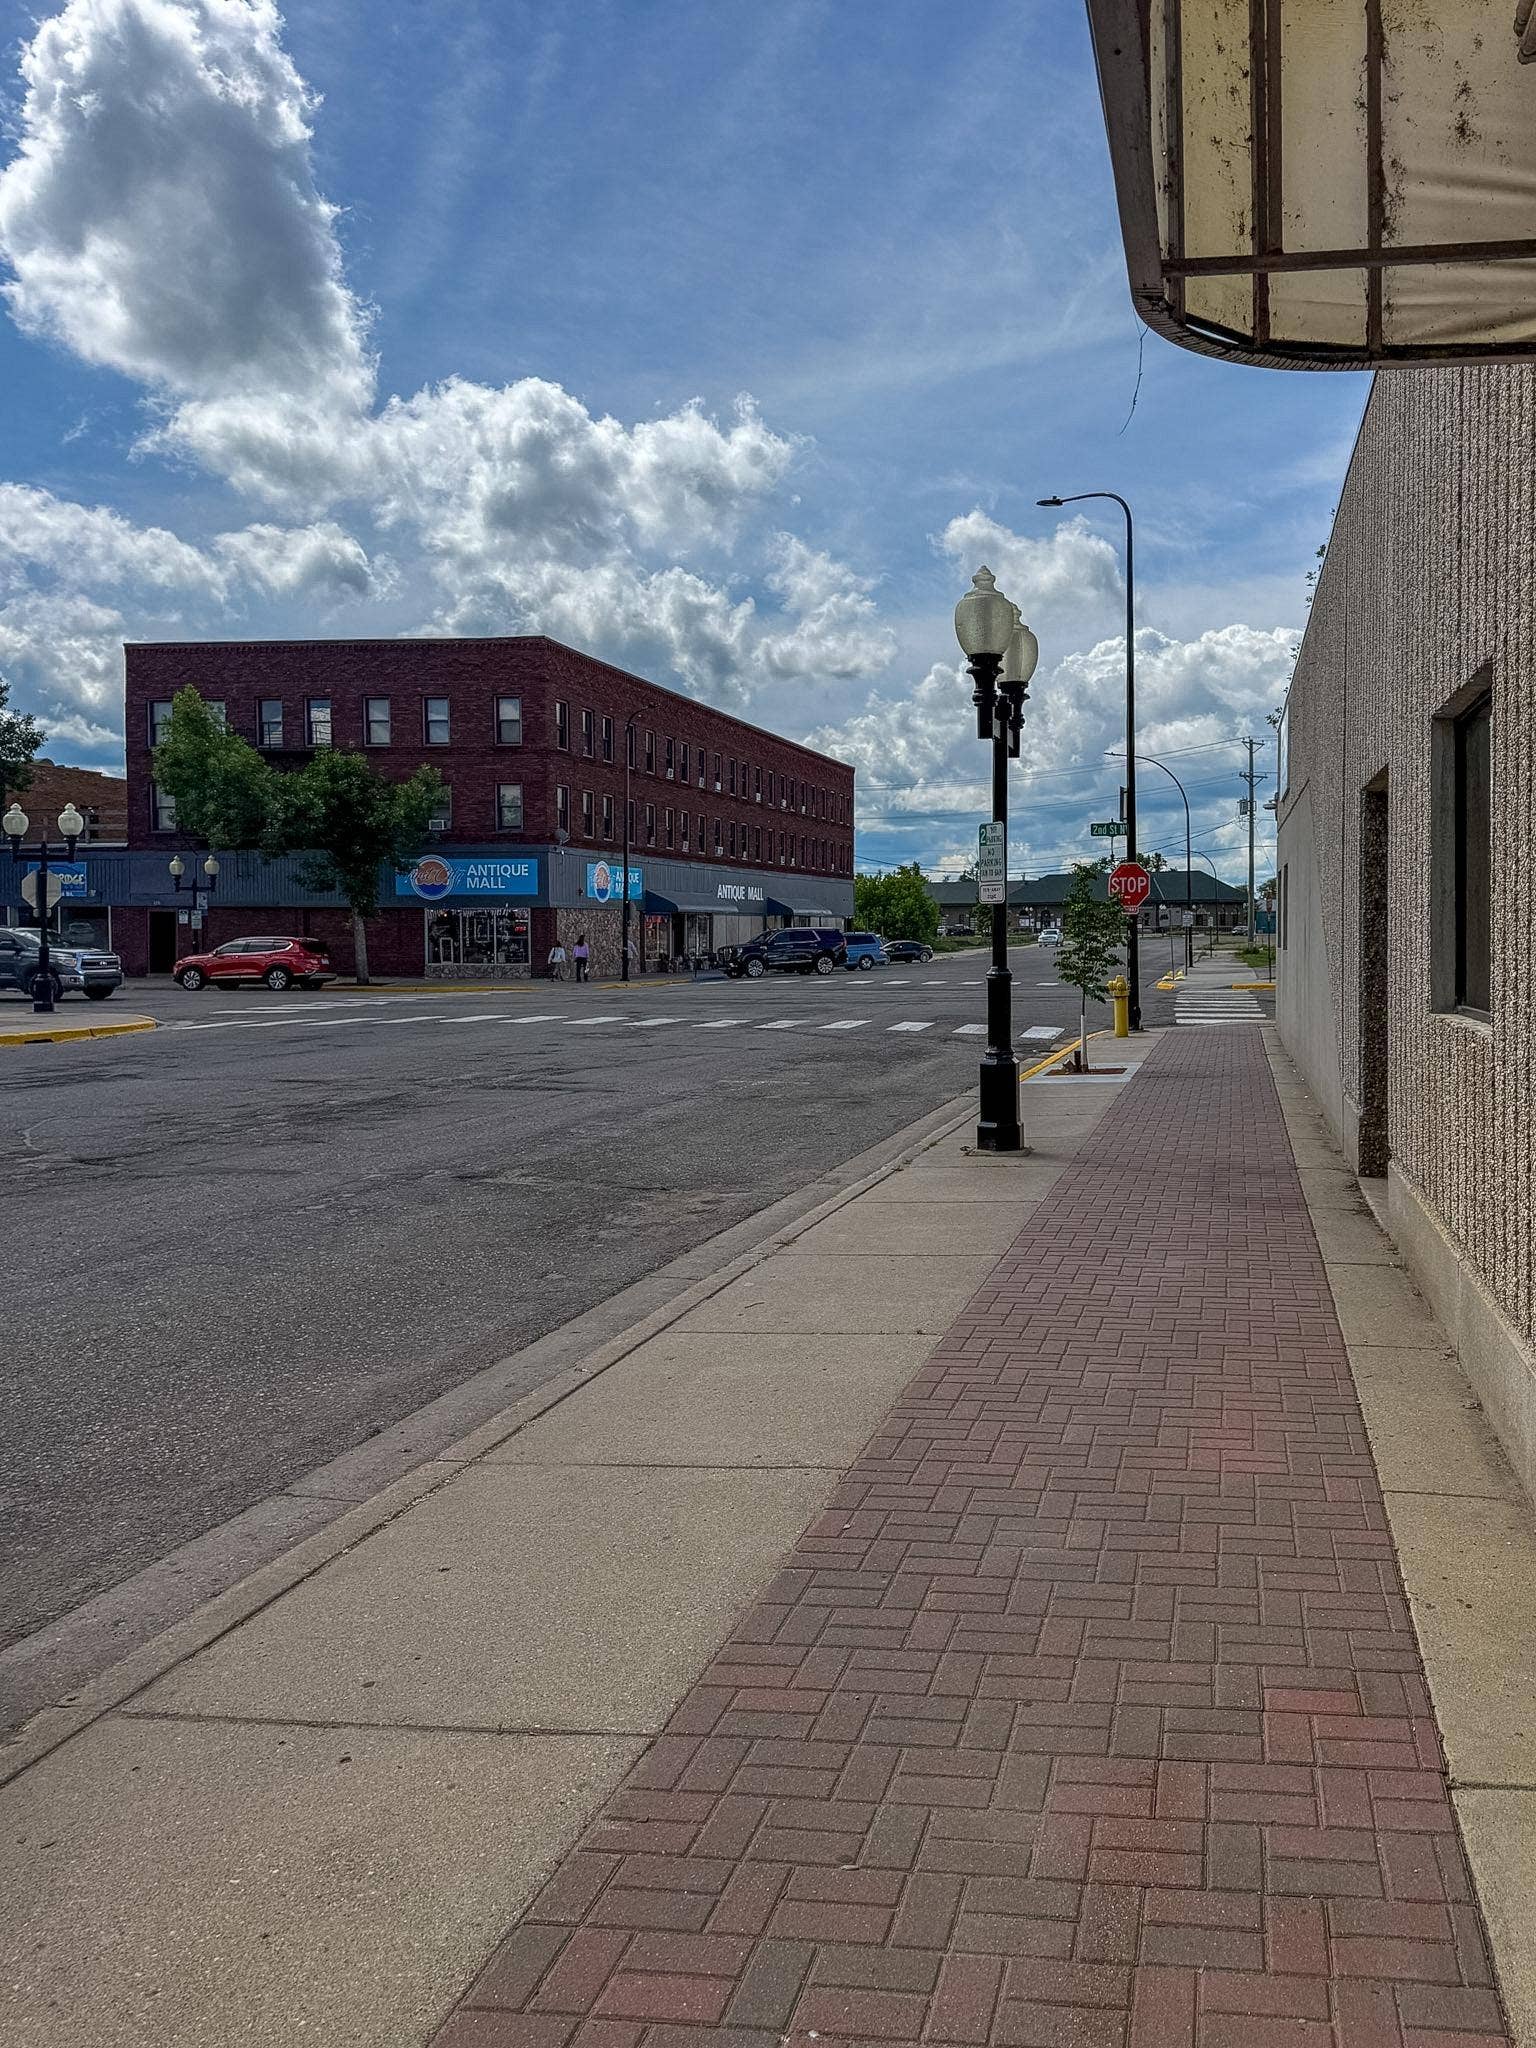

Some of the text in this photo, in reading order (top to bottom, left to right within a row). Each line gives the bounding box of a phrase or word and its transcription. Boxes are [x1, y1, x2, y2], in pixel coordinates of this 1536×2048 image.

[980, 828, 986, 844] 2
[1093, 825, 1107, 835] 2nd
[1109, 825, 1118, 835] St
[981, 857, 1002, 866] PARKING
[466, 864, 529, 878] ANTIQUE
[466, 877, 506, 889] MALL
[1111, 876, 1147, 893] STOP
[717, 884, 764, 901] ANTIQUE MALL
